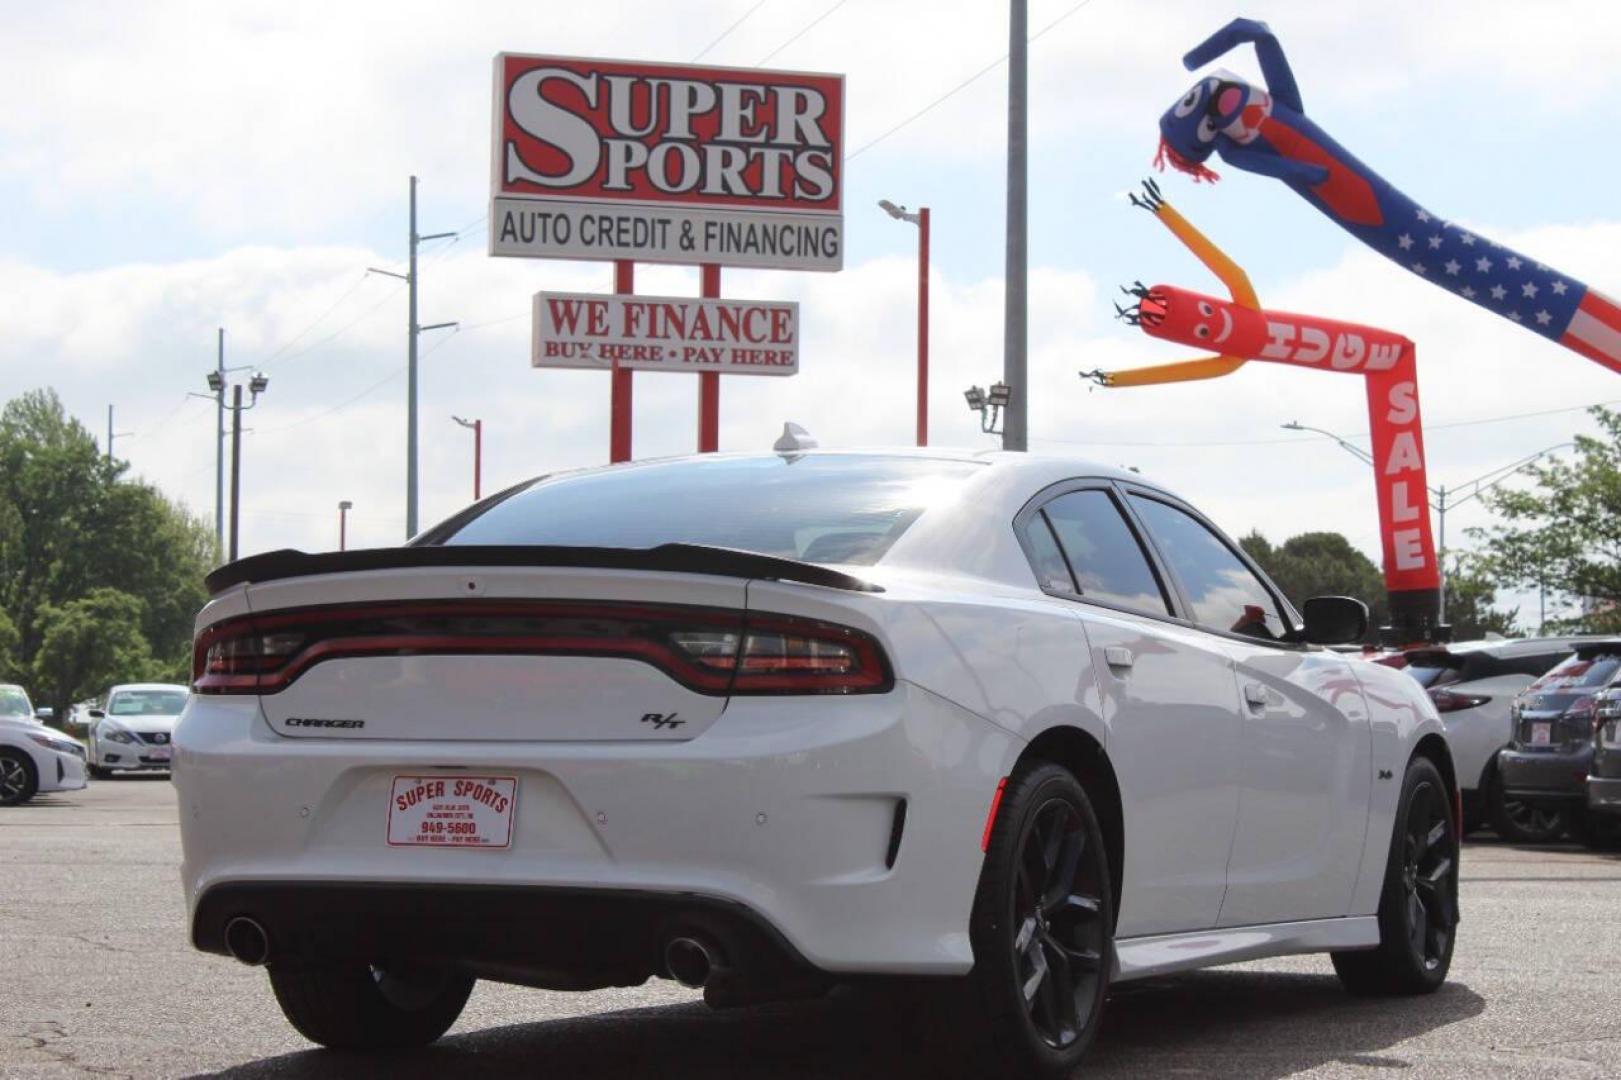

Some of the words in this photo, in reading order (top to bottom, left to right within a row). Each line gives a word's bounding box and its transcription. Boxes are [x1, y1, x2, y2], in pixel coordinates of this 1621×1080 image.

[508, 67, 832, 187] SUPER
[500, 211, 571, 246] AUTO
[579, 214, 671, 250] CREDIT
[679, 219, 696, 251] &
[704, 221, 839, 258] FINANCING
[547, 299, 610, 337] WE
[621, 302, 793, 344] FINANCE
[544, 340, 592, 358] BUY
[598, 342, 664, 362] HERE
[681, 346, 725, 364] PAY
[730, 349, 795, 367] HERE
[1260, 321, 1402, 370] HUGE
[1384, 381, 1426, 571] SALE
[284, 718, 365, 729] CHARGER
[640, 712, 686, 730] R/T
[395, 780, 445, 811] SUPER
[453, 779, 509, 813] SPORTS
[421, 821, 476, 834] 949-5600
